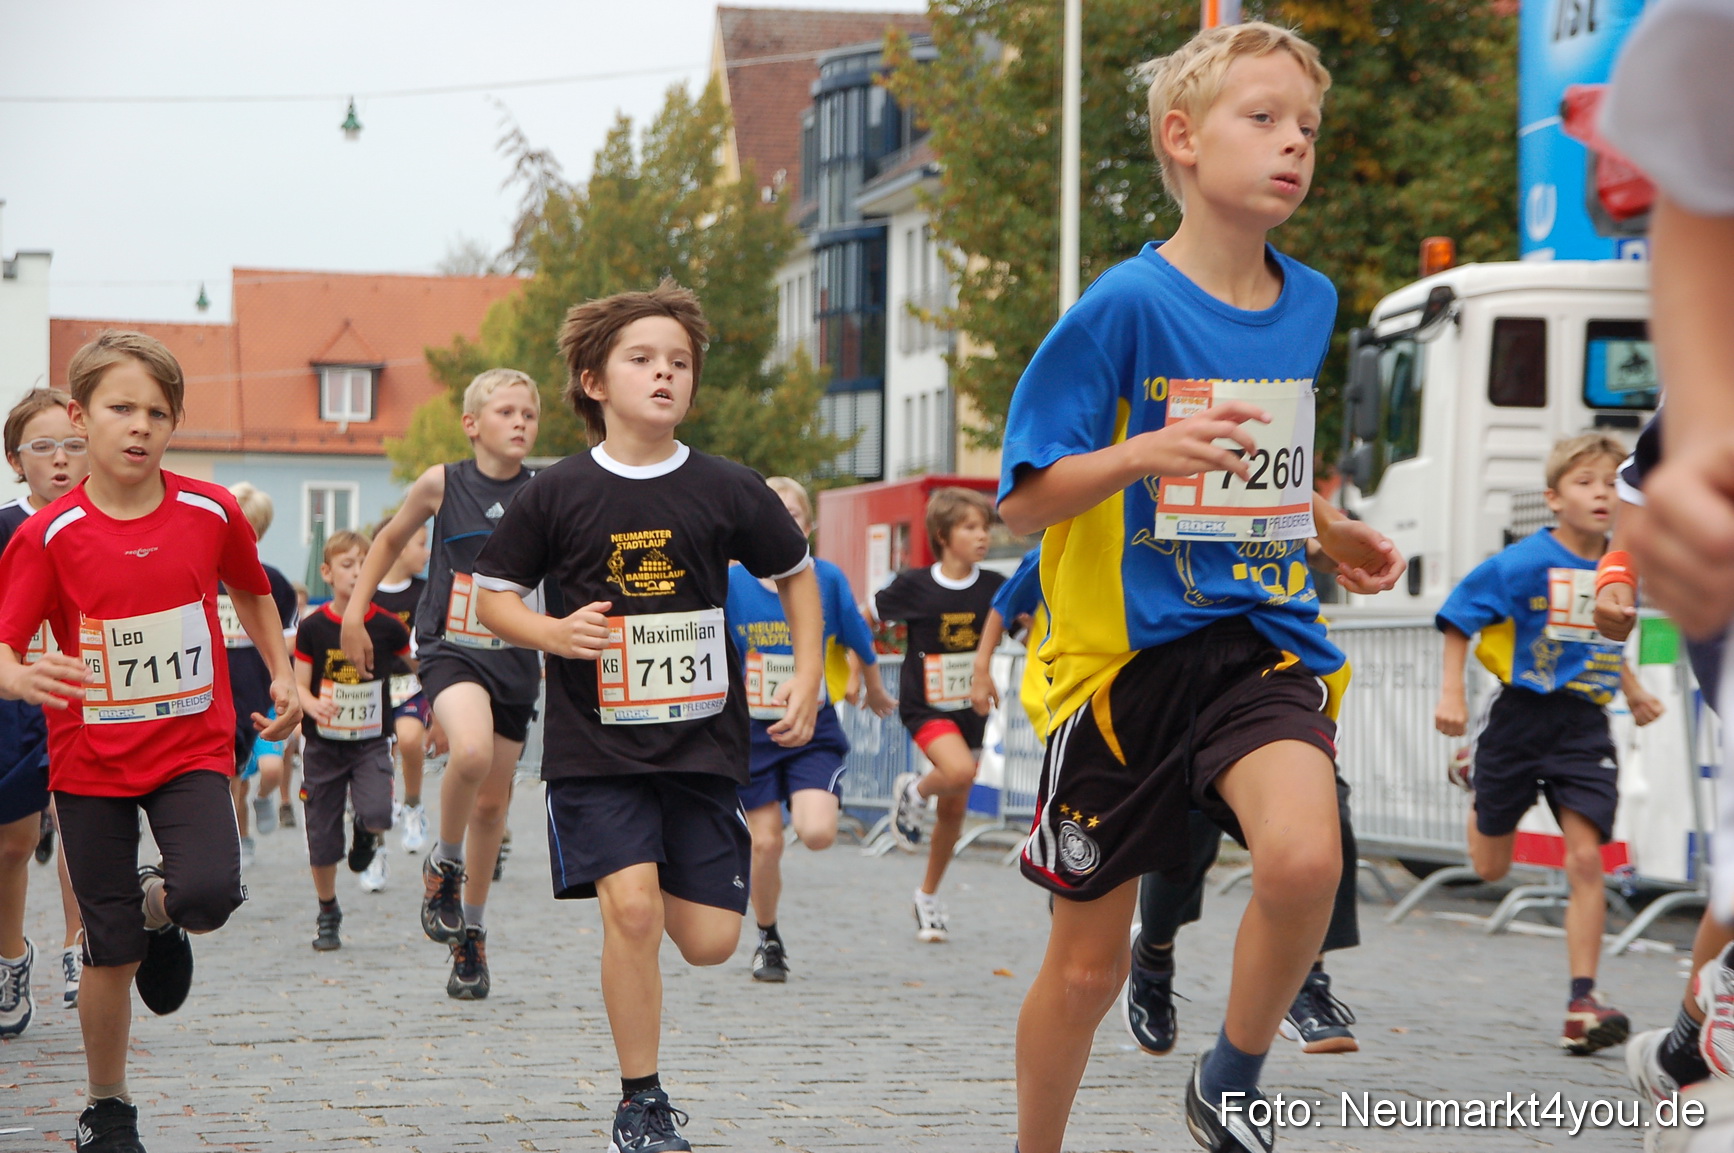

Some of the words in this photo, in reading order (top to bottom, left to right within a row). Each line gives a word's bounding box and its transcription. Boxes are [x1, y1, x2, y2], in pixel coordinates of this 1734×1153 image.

[1221, 445, 1304, 490] 7260
[610, 529, 672, 543] NEUMARKTER
[616, 538, 667, 551] STADTLAUF
[111, 627, 144, 647] Leo
[632, 621, 716, 645] Maximilian
[118, 645, 202, 687] 7117
[602, 658, 619, 674] K6
[636, 652, 713, 687] 7131
[336, 703, 376, 722] 7137
